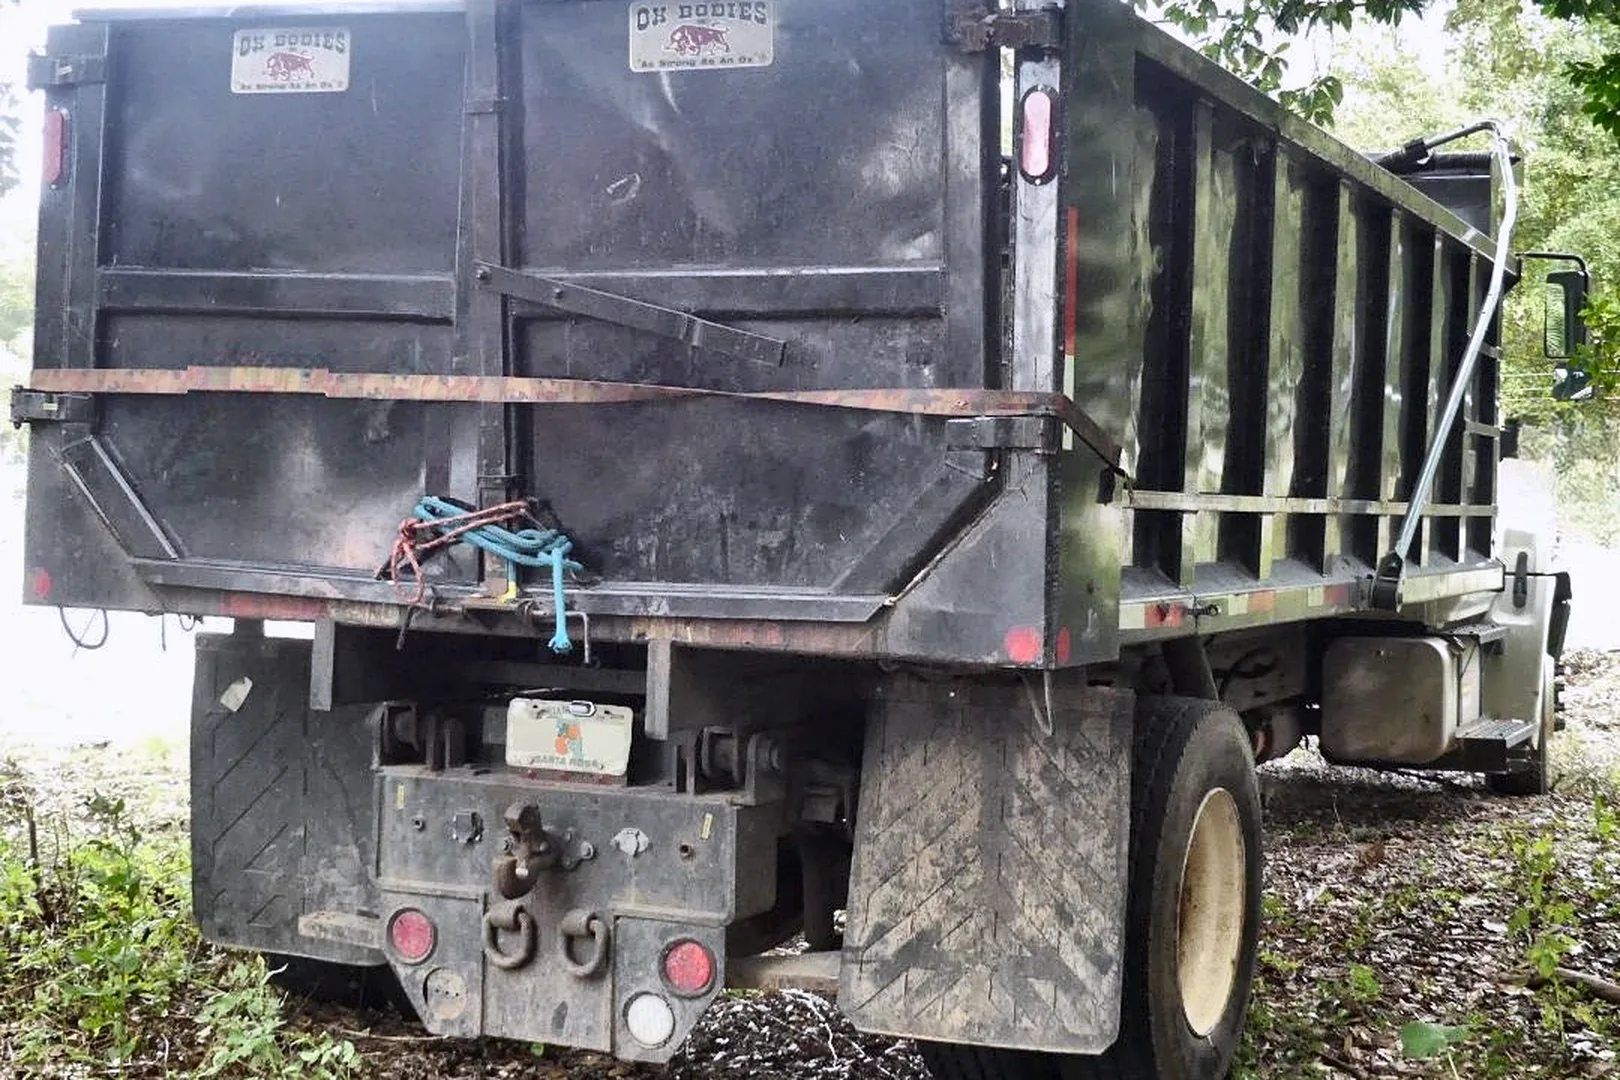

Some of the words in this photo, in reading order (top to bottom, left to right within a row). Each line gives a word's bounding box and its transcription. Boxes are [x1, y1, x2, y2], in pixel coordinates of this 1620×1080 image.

[637, 5, 667, 31] OX
[679, 1, 768, 25] BODIES
[239, 35, 265, 57] OX
[274, 32, 346, 54] BODIES
[659, 59, 697, 68] Strong
